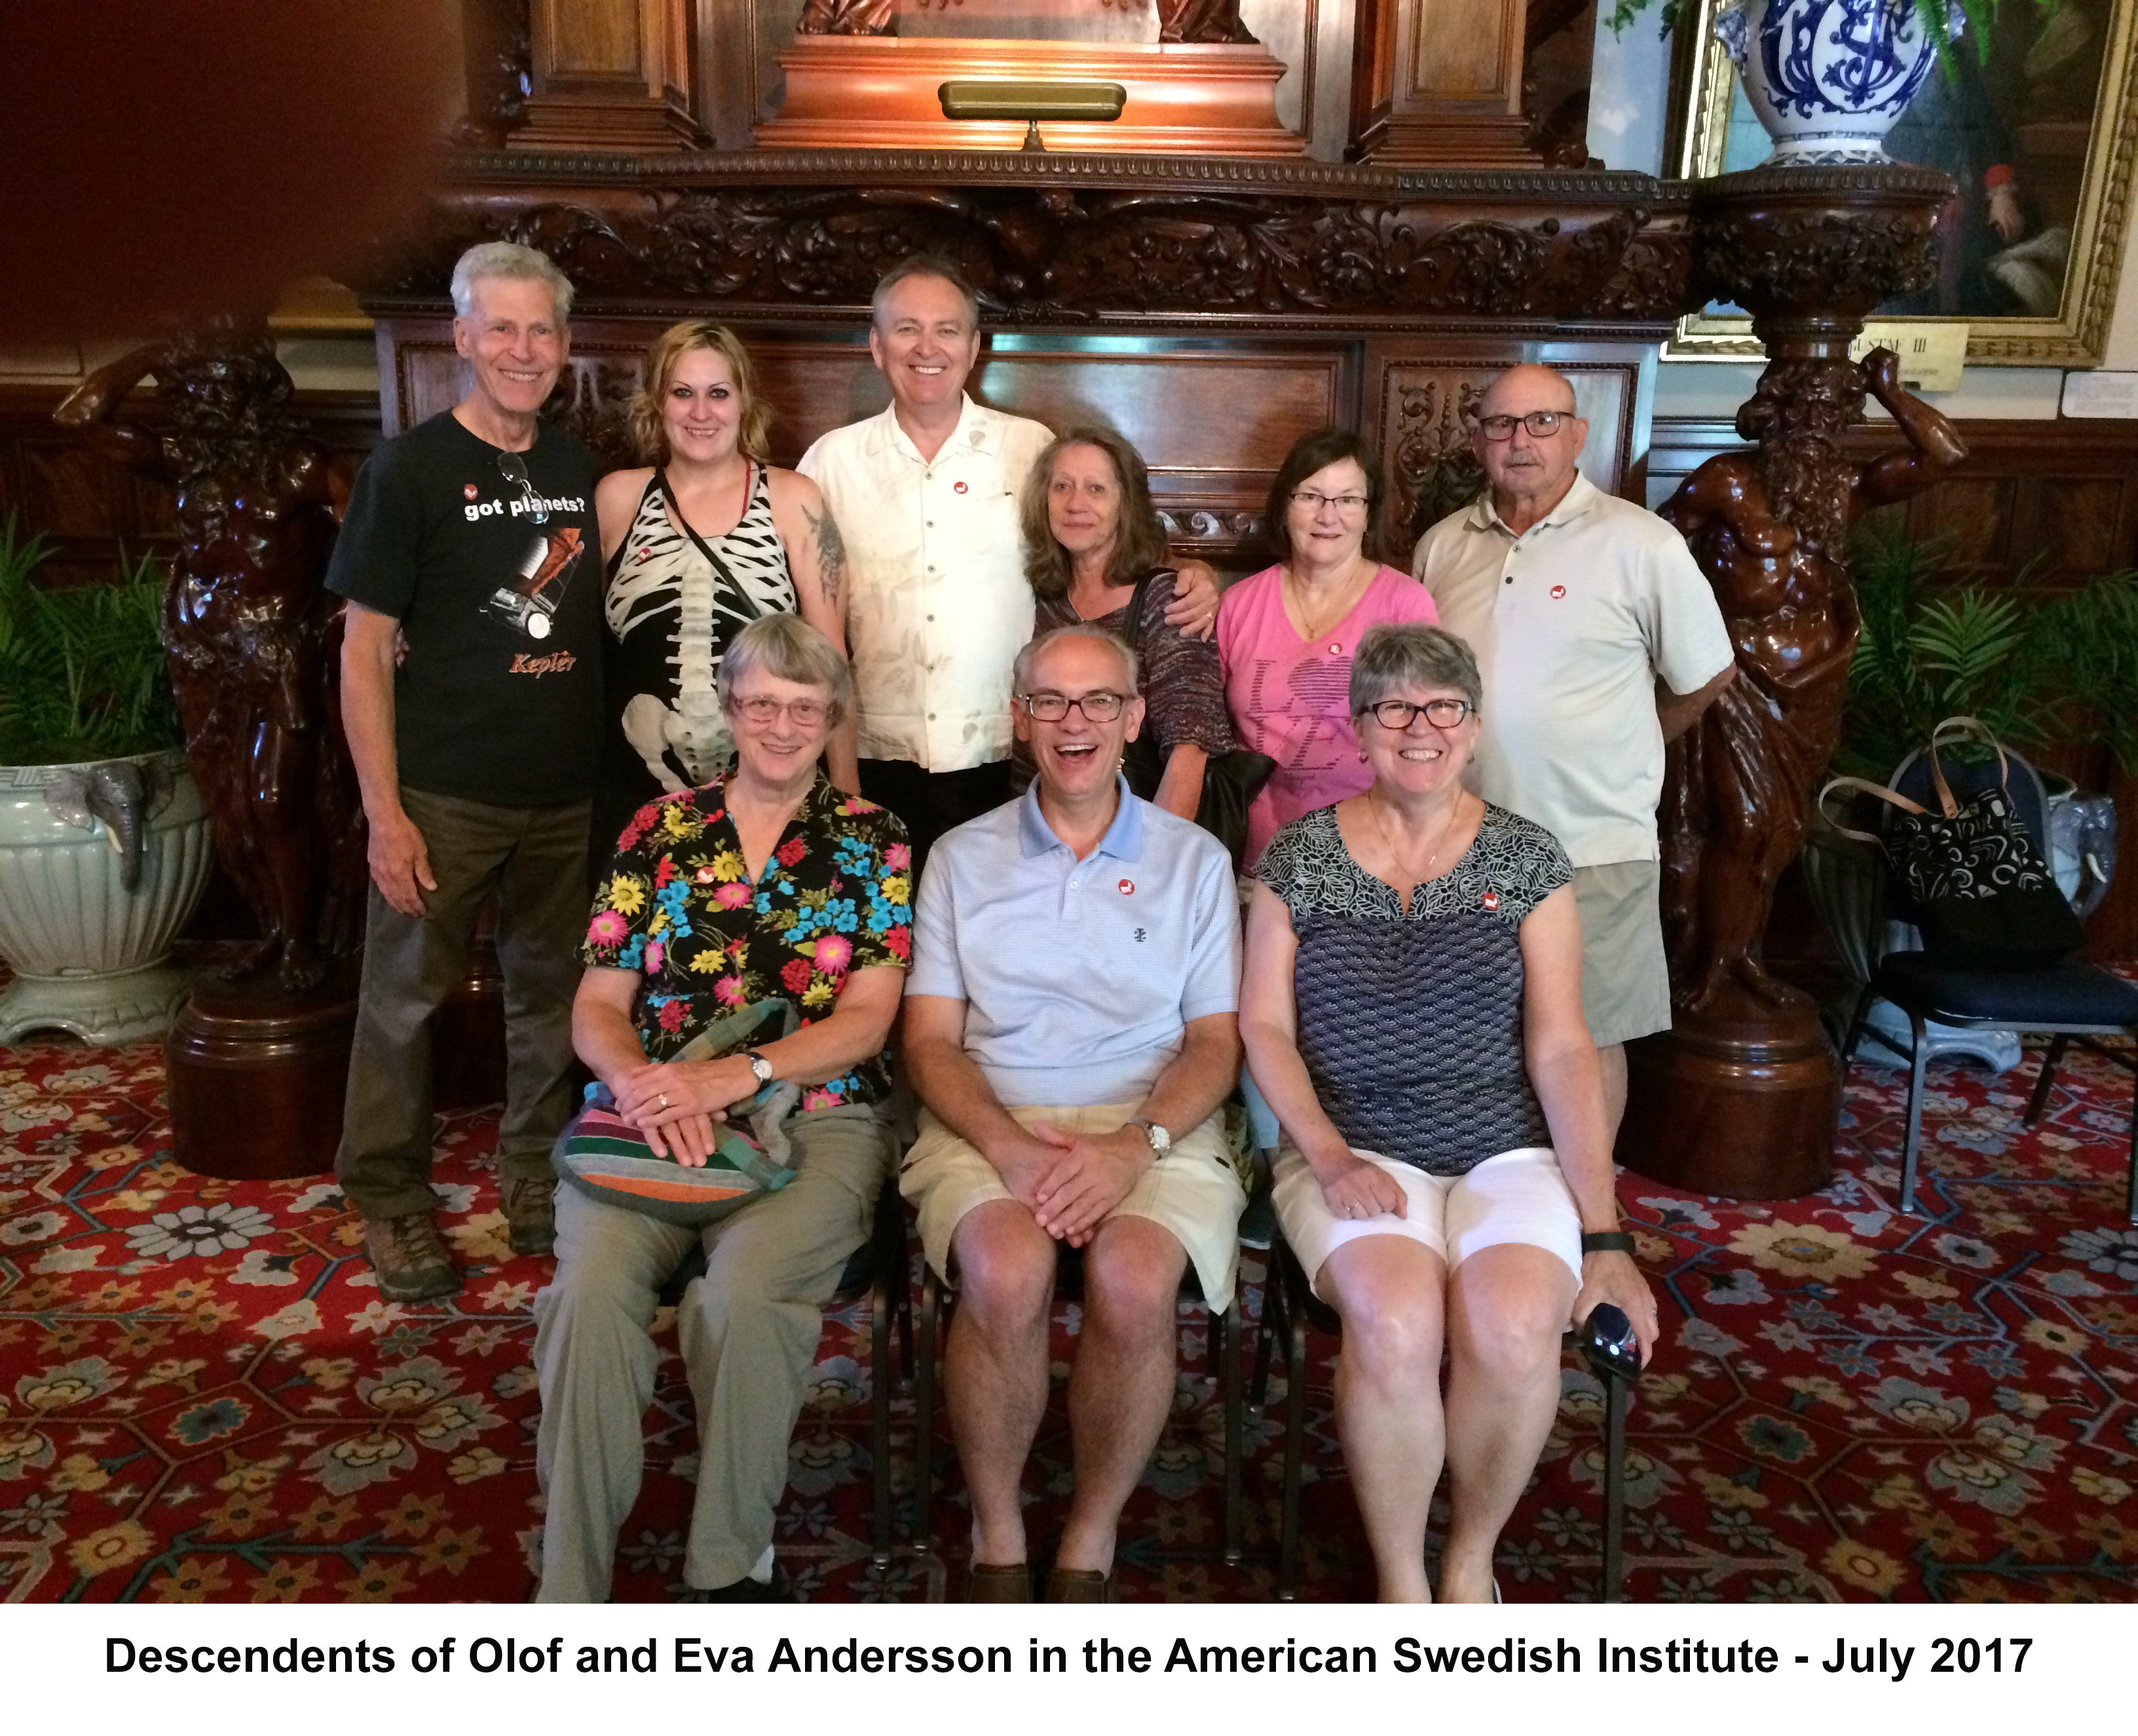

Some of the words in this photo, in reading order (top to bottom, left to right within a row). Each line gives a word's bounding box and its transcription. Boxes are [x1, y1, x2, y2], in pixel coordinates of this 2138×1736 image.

[1913, 338, 1927, 352] III
[464, 499, 504, 521] got
[510, 495, 586, 518] planets?
[508, 651, 577, 679] Kepler
